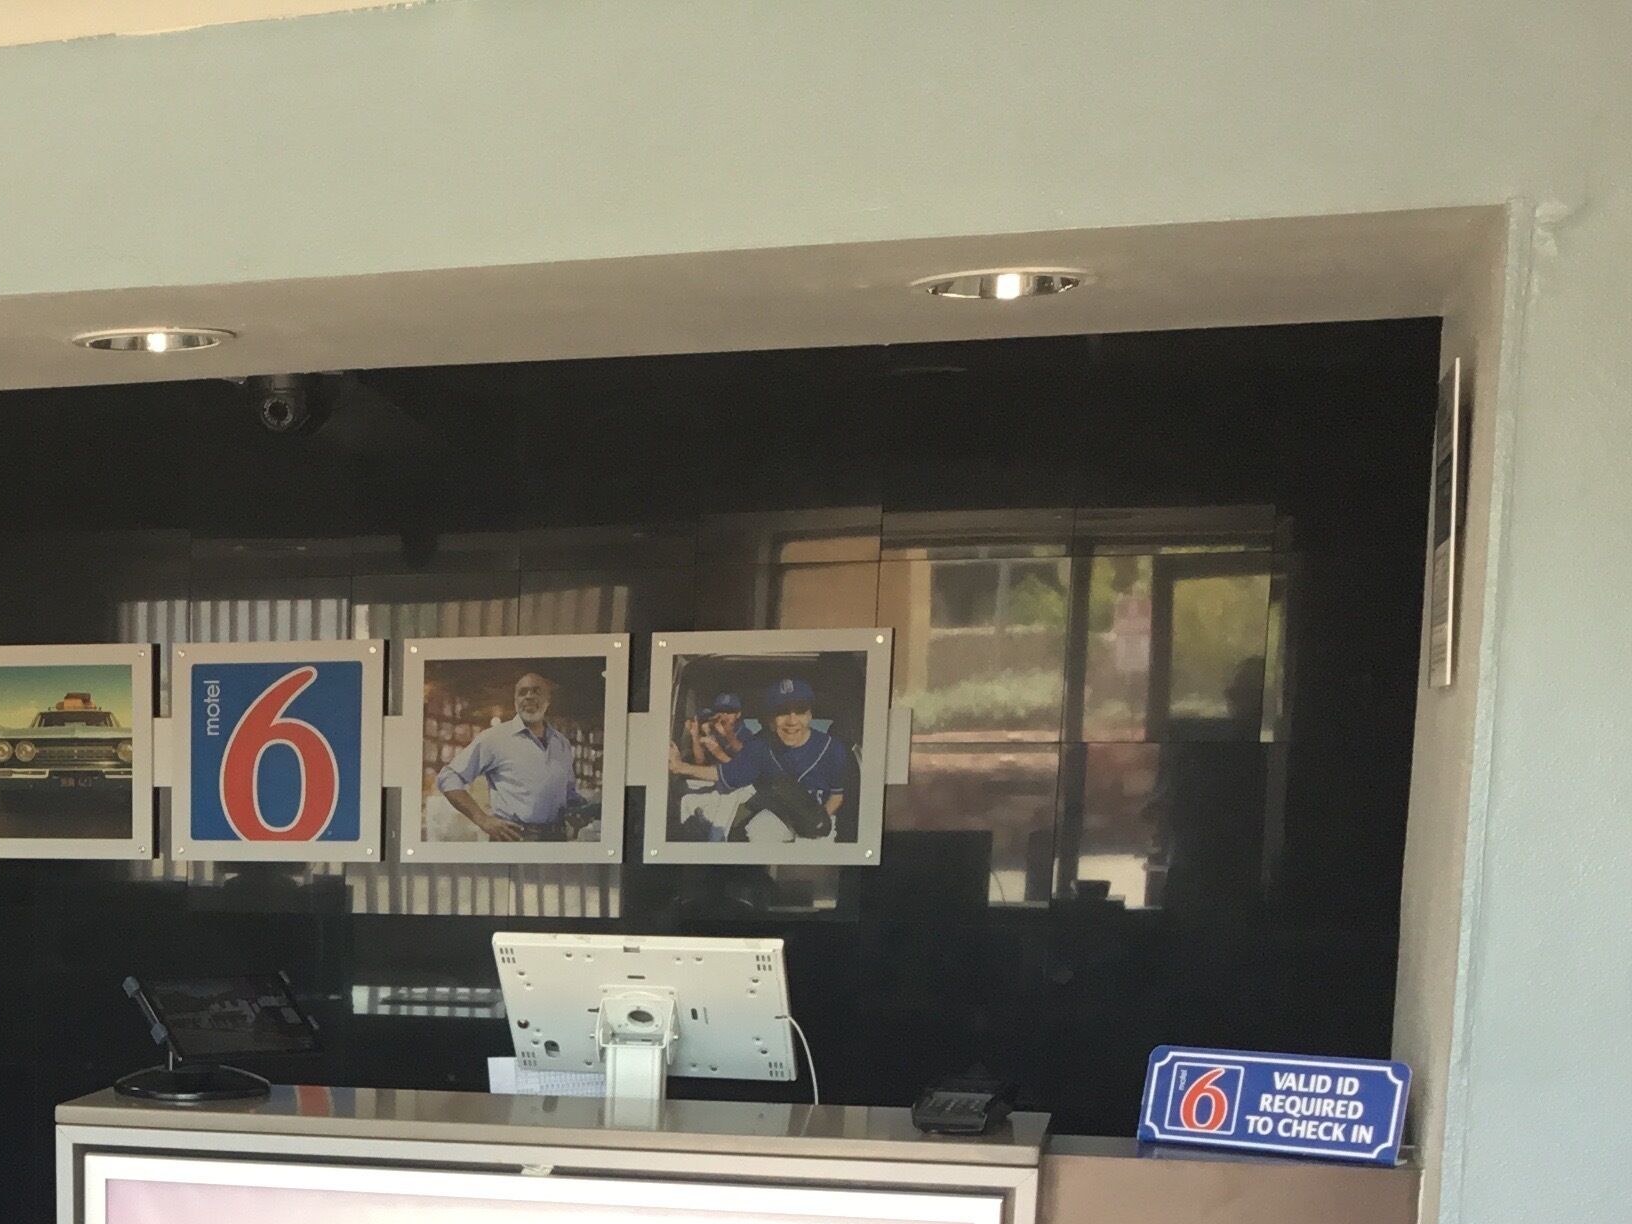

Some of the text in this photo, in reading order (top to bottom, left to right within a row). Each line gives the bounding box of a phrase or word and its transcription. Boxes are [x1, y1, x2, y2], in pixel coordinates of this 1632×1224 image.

[204, 680, 220, 736] motel
[219, 666, 339, 841] 6
[1180, 1067, 1228, 1133] 6
[1273, 1072, 1359, 1096] VALID ID
[1259, 1094, 1364, 1120] REQUIRED
[1245, 1115, 1374, 1144] TO CHECK IN
